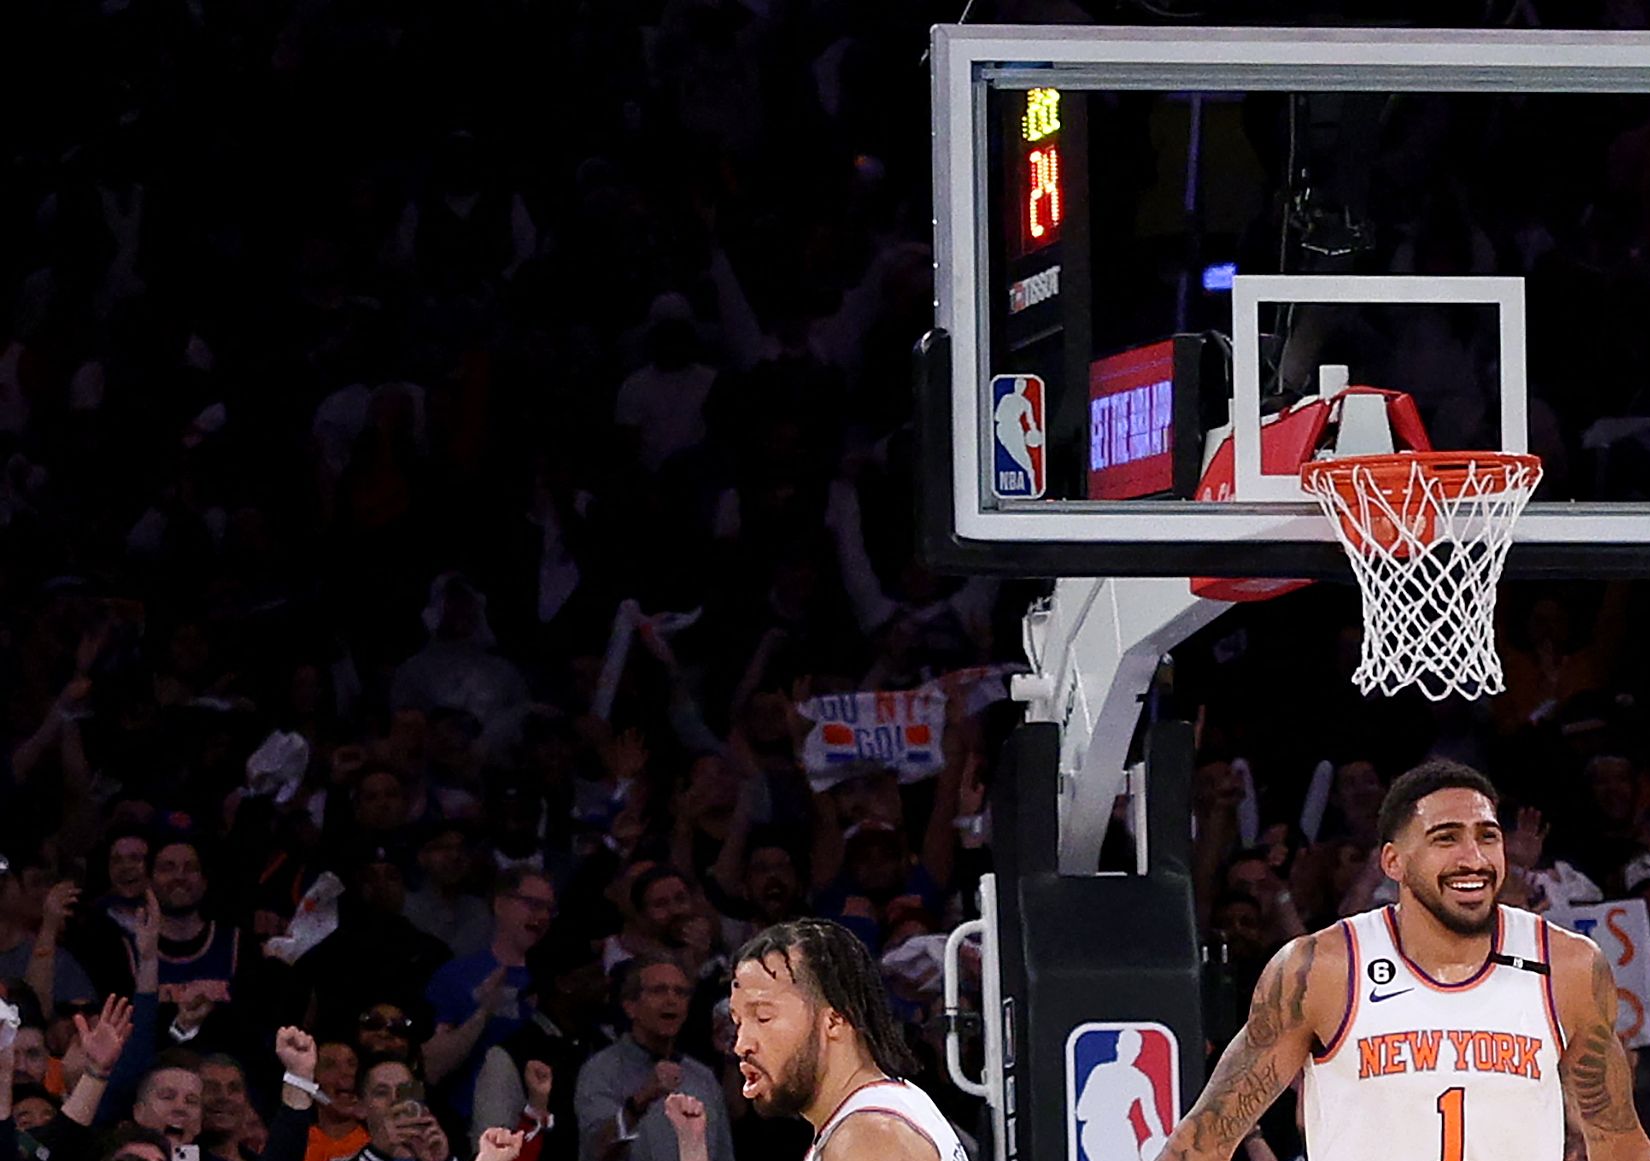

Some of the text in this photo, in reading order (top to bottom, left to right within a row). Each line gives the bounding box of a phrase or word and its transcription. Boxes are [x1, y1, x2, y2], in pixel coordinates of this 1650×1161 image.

[1029, 145, 1060, 238] 24
[999, 470, 1026, 491] NBA
[1373, 961, 1390, 983] 6
[1357, 1030, 1543, 1082] NEW YORK
